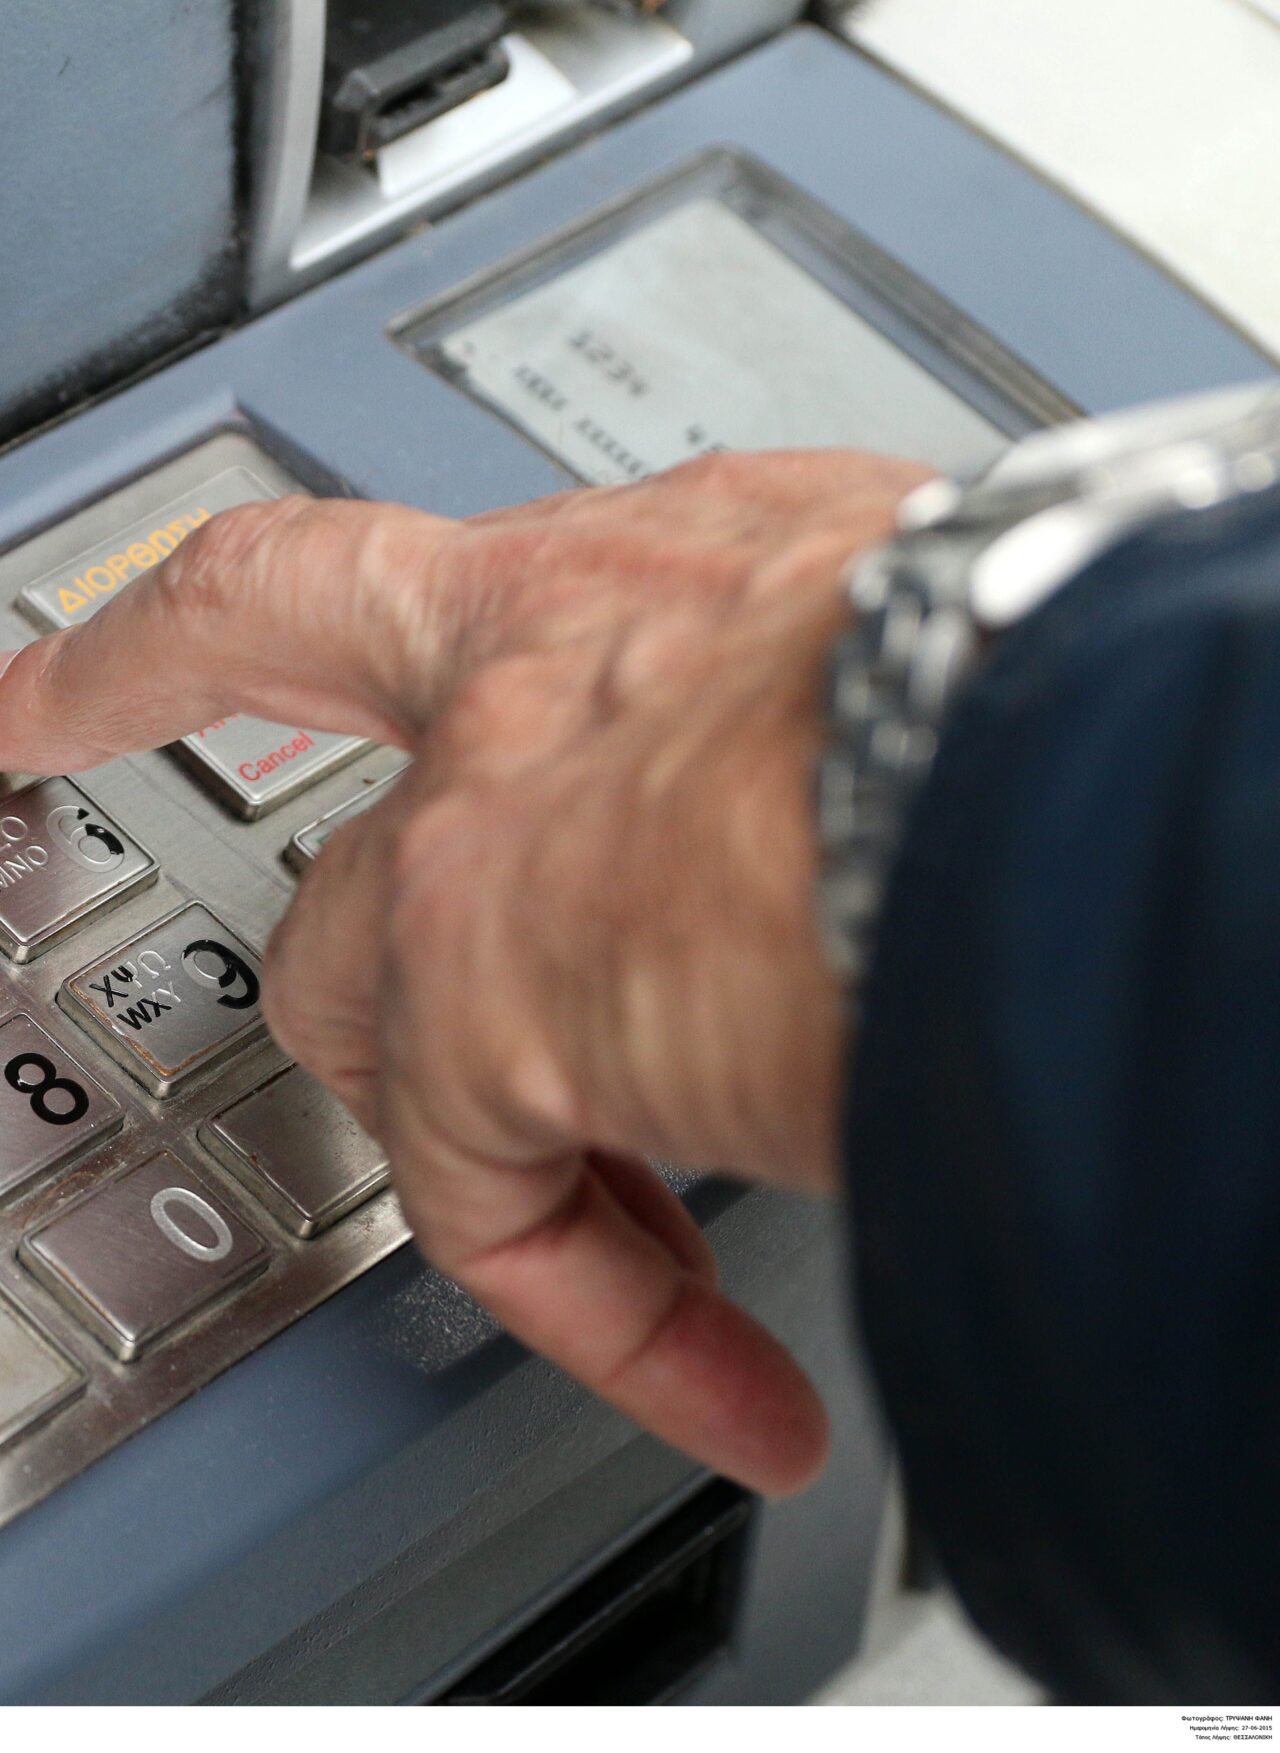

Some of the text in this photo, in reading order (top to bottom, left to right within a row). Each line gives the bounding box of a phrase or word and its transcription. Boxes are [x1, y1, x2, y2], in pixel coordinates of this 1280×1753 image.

[238, 730, 316, 783] Cancel
[46, 805, 125, 873] 6
[116, 981, 181, 1030] WXY
[180, 939, 260, 1009] 9
[4, 1052, 90, 1125] 8
[150, 1187, 233, 1261] 0
